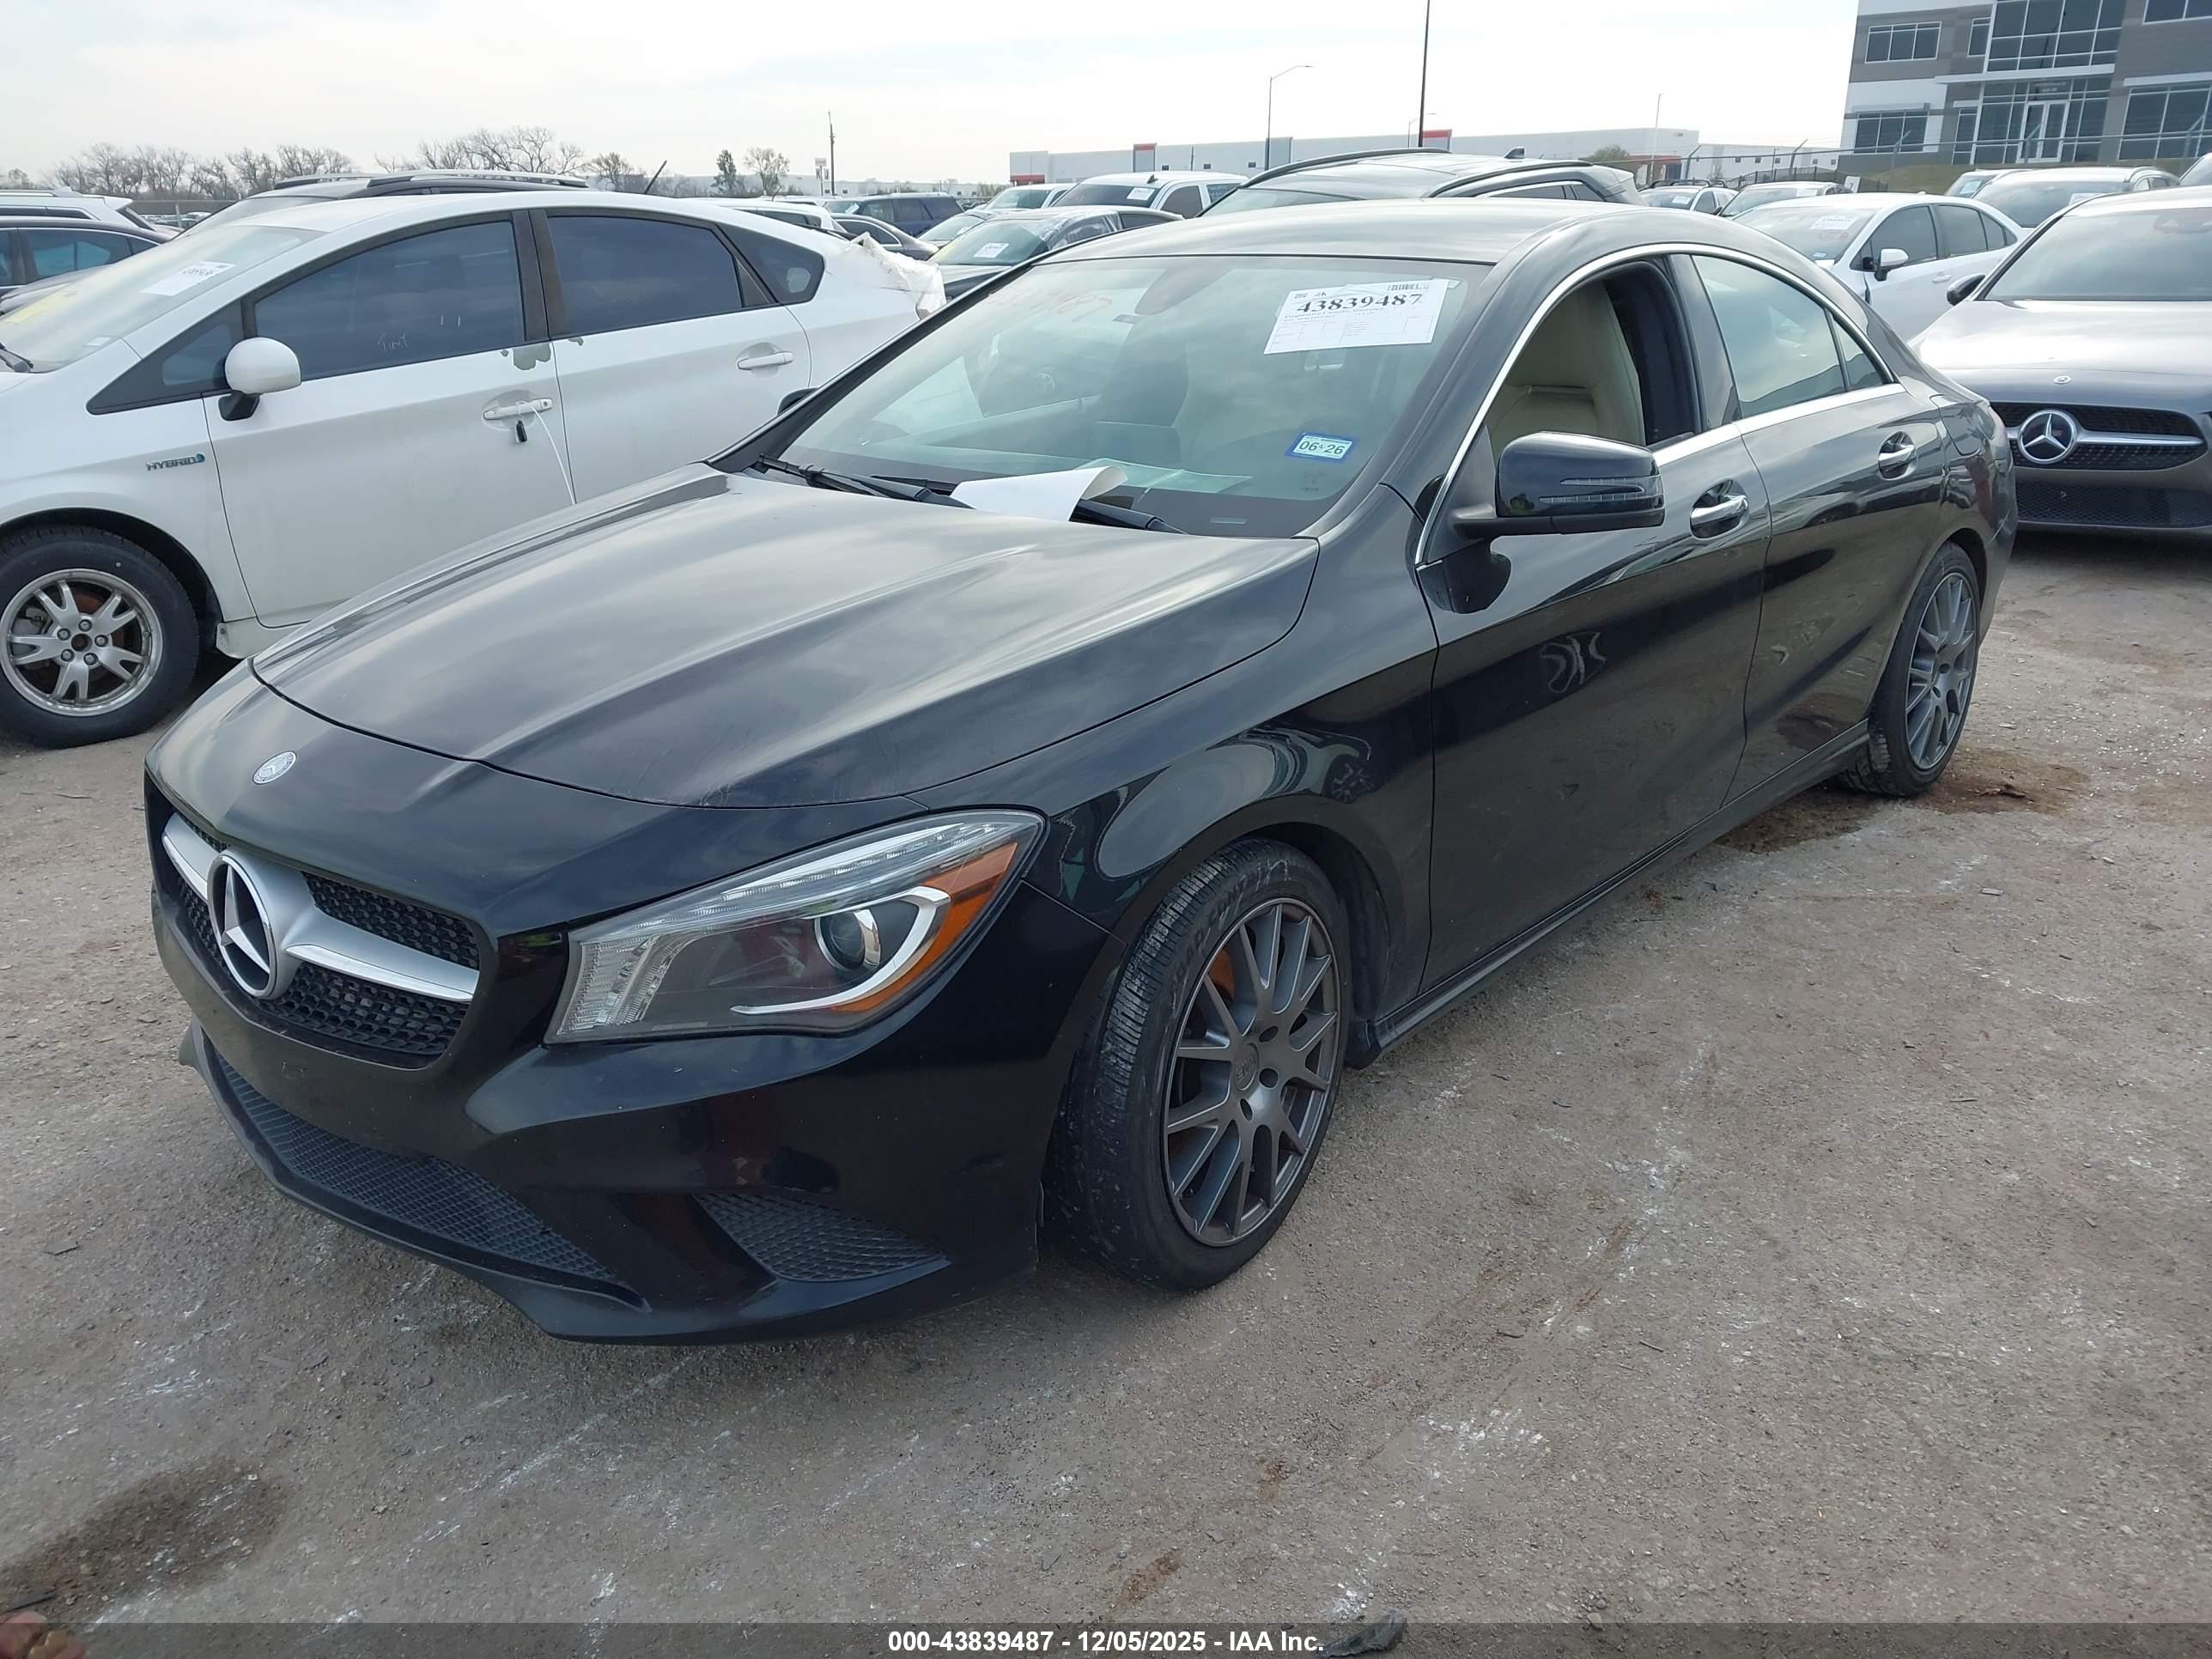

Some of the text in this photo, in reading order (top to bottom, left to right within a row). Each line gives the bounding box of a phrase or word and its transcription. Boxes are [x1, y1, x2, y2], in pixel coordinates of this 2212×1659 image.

[1297, 294, 1423, 313] 43839487
[1299, 441, 1320, 452] 06
[1323, 444, 1344, 454] 26
[145, 456, 197, 471] HYBRID
